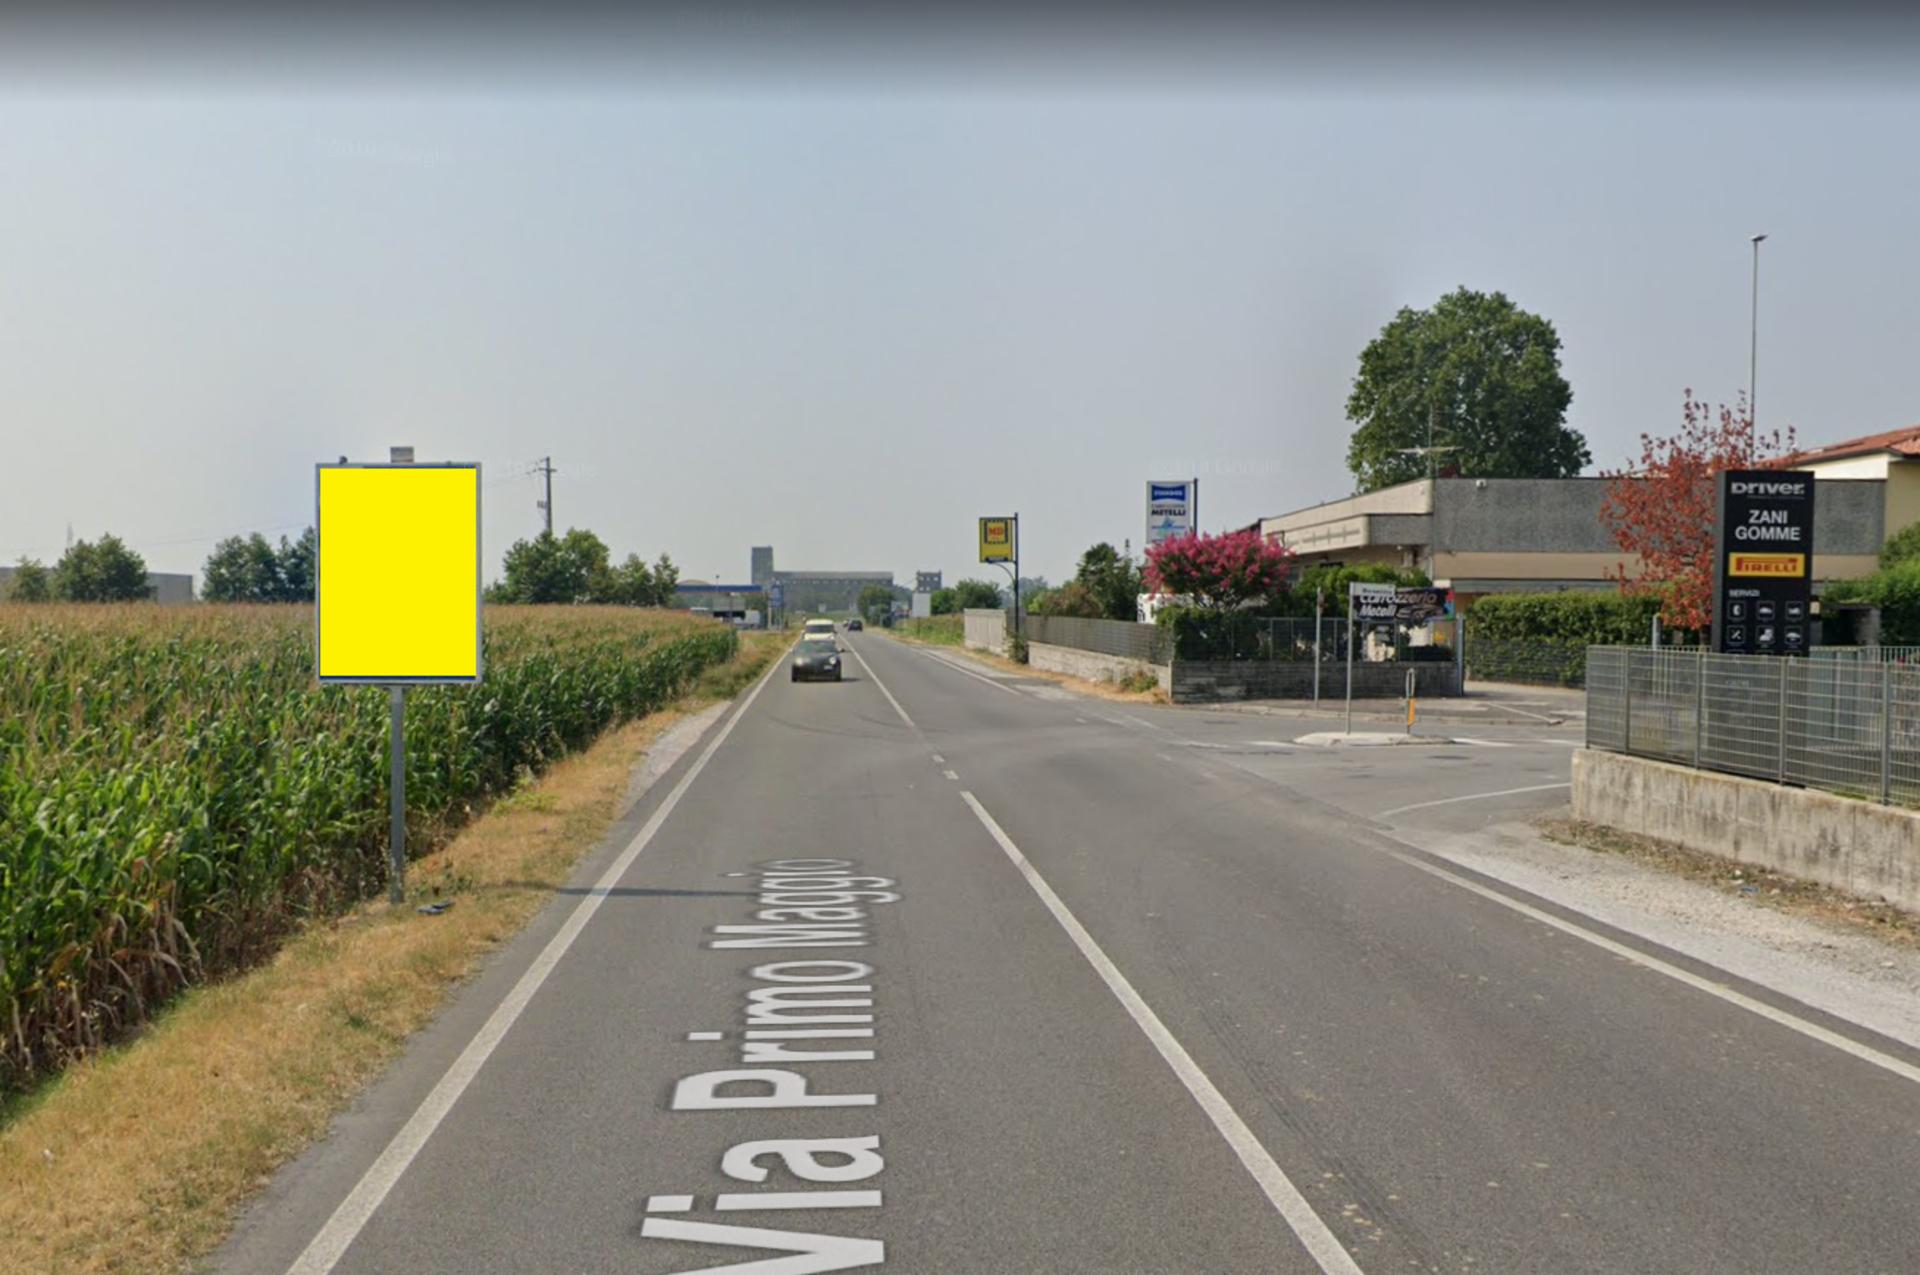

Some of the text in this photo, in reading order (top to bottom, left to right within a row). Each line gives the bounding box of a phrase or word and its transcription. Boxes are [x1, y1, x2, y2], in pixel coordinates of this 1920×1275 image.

[1748, 509, 1788, 524] ZANI
[1734, 526, 1801, 541] GOMME
[1735, 557, 1798, 572] PIRELLI
